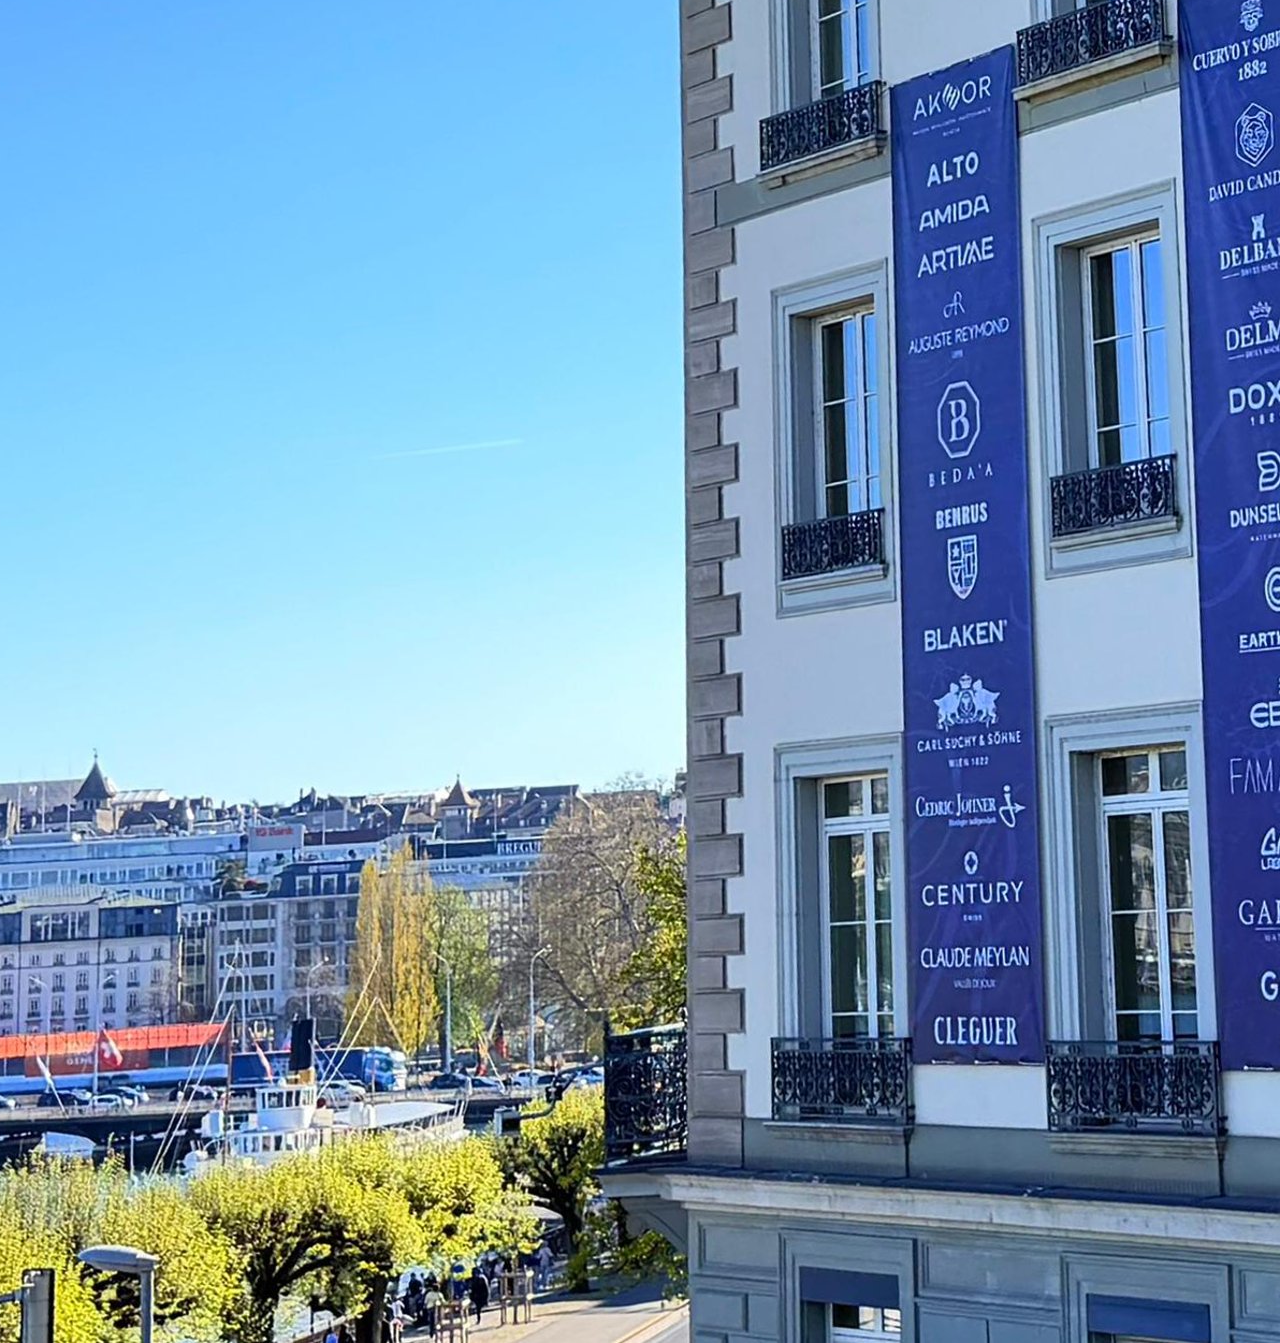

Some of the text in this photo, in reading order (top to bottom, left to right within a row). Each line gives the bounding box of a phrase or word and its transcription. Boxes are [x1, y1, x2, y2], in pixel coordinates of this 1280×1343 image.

[1192, 43, 1240, 71] CUERVO
[1241, 39, 1251, 57] Y
[1238, 59, 1268, 82] 1882
[927, 151, 979, 187] ALTO
[1209, 179, 1244, 202] DAVID
[919, 195, 990, 232] AMIDA
[908, 317, 1010, 354] AUGUSTE REYMOND
[935, 502, 988, 530] BENRUS
[917, 740, 943, 752] CARL
[945, 735, 978, 750] SUCHY
[497, 841, 542, 855] BREGU
[921, 881, 1024, 907] CENTURY
[920, 946, 1030, 968] CLAUDE MEYLAN
[934, 1016, 1018, 1045] CLEGUER
